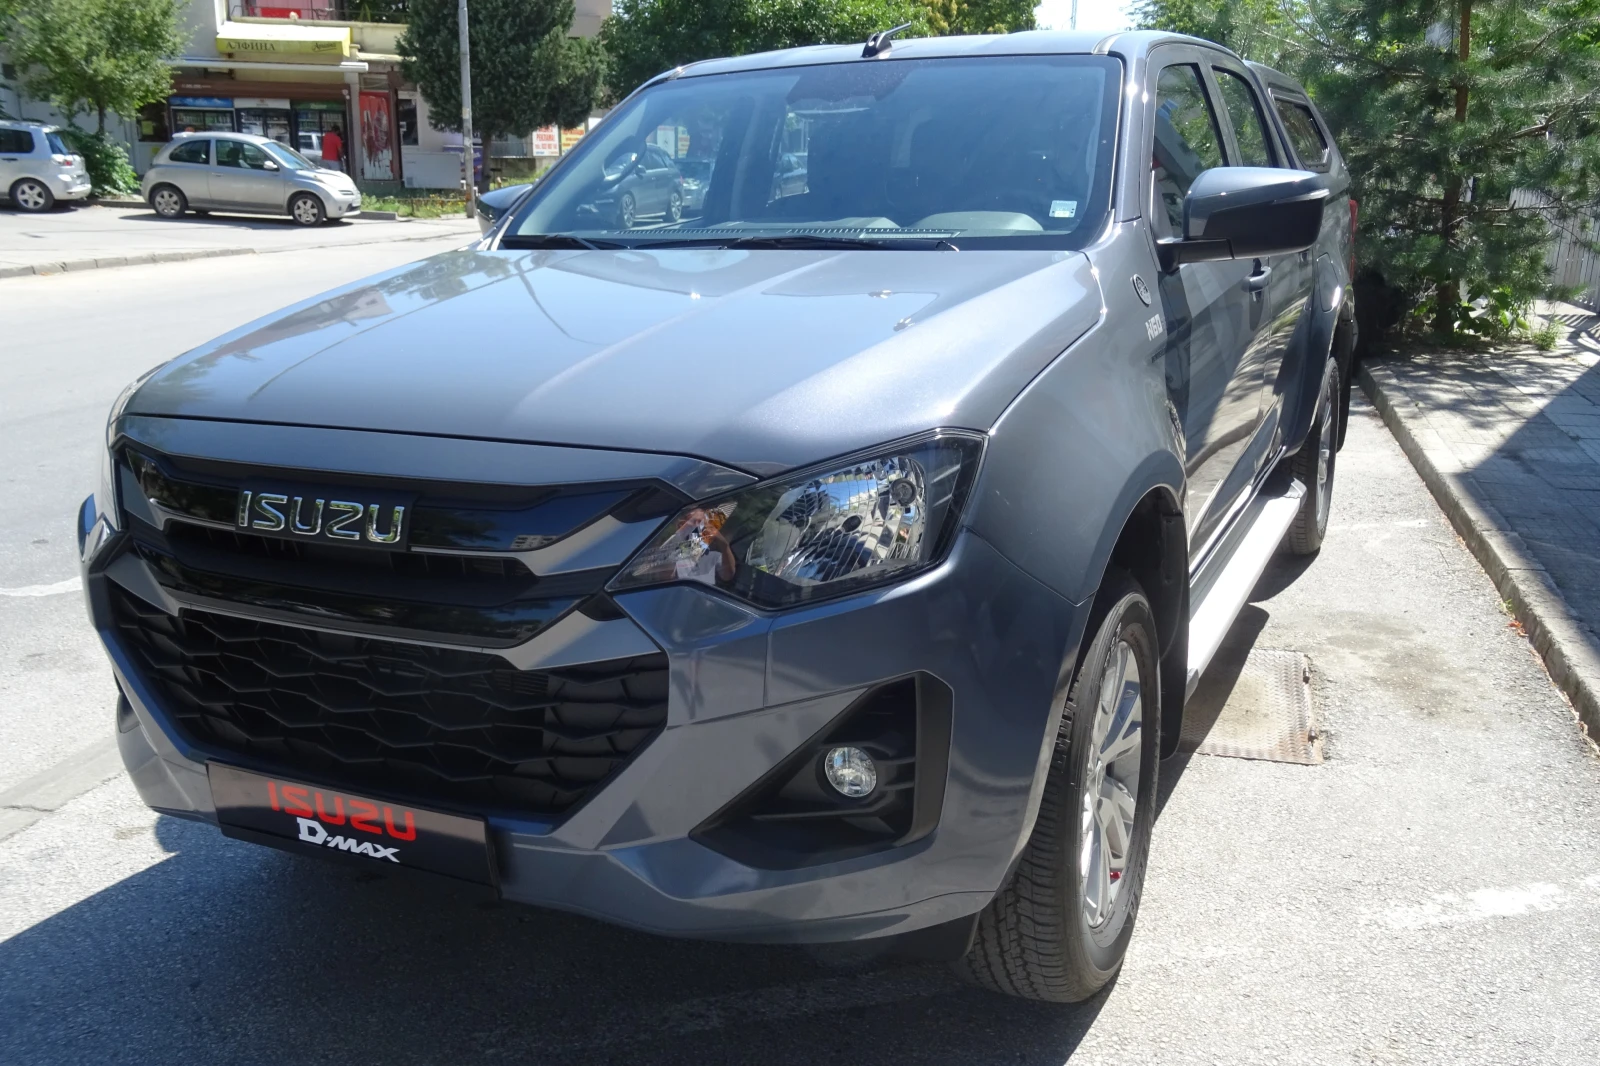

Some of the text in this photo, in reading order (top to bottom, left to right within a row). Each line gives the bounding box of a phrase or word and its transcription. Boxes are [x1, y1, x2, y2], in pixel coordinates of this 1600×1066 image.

[226, 41, 276, 51] АЛФИНА
[239, 490, 405, 543] ISUZU
[267, 781, 416, 841] ISUZU
[296, 817, 400, 863] D-MAX
